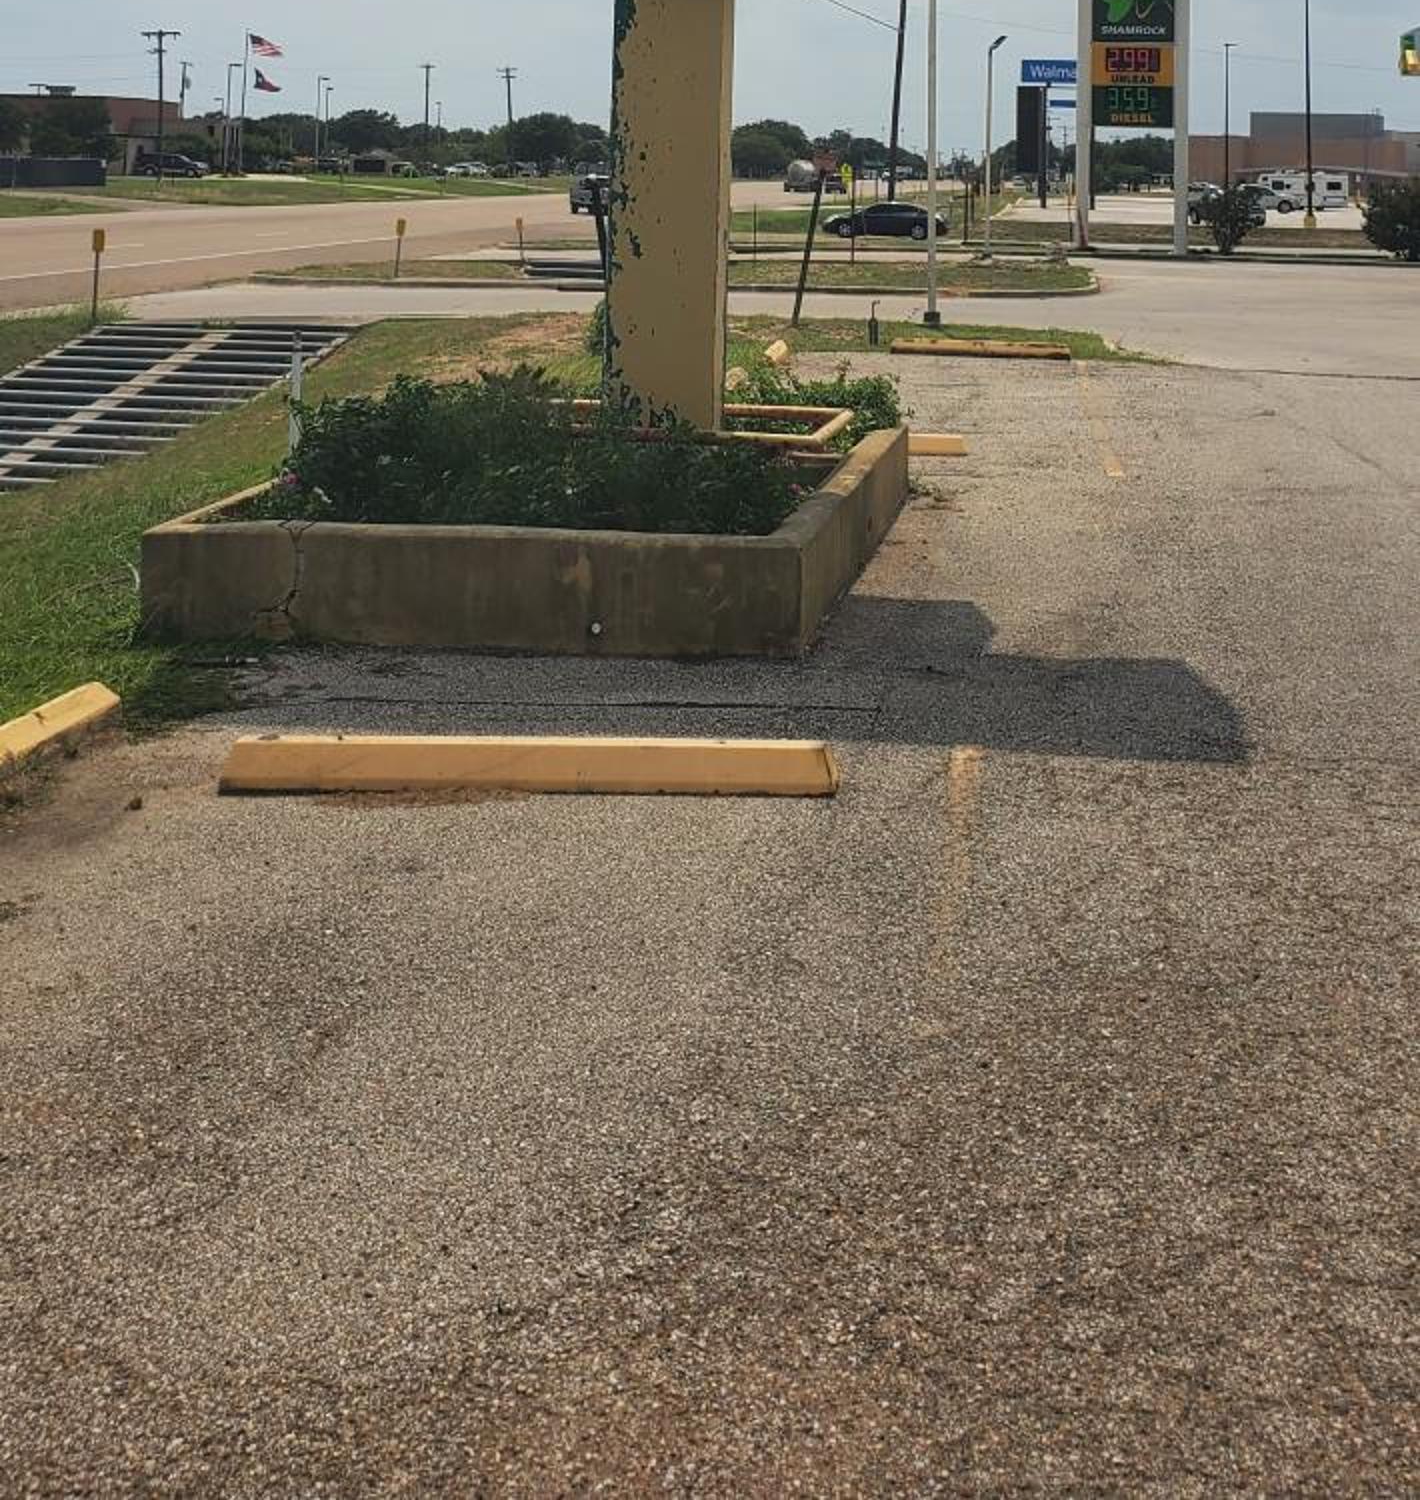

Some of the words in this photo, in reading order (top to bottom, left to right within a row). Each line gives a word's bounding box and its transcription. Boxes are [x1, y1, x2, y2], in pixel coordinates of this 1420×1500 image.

[1101, 25, 1166, 35] SHAMROCK
[1111, 74, 1155, 84] UNLEAD
[1111, 113, 1153, 123] DIESEL
